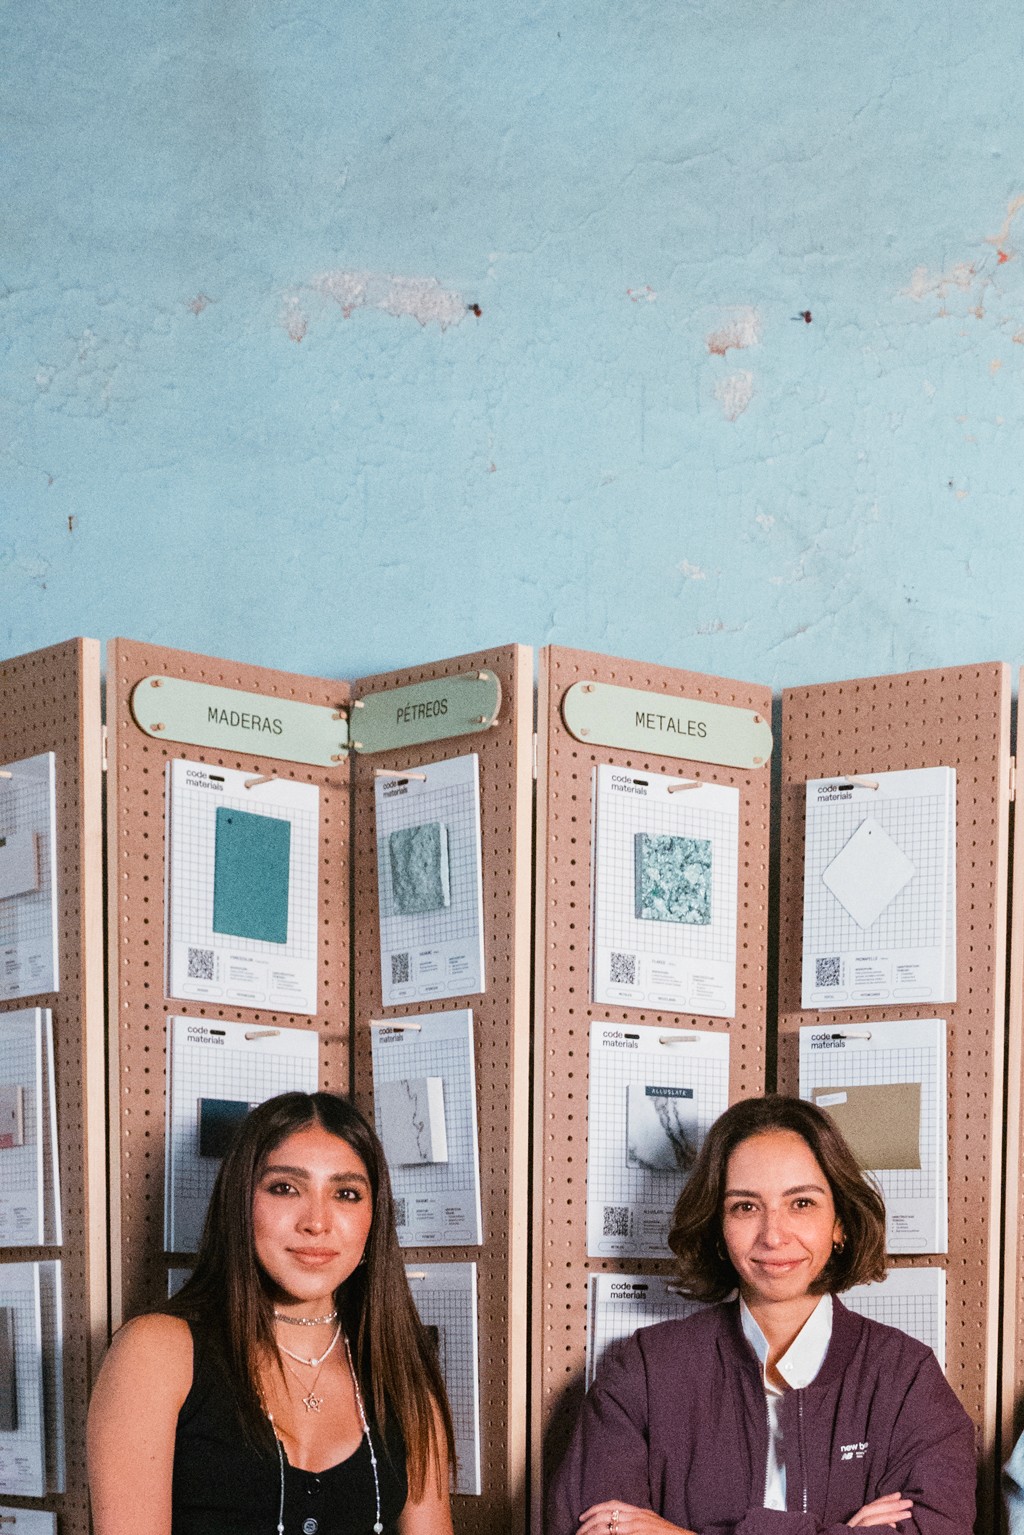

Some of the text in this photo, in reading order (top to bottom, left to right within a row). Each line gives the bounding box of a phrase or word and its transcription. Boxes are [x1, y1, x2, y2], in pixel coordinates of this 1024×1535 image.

[396, 698, 448, 724] PÉTREOS
[208, 706, 283, 735] MADERAS
[636, 711, 707, 738] METALES
[186, 770, 207, 779] code
[611, 775, 631, 783] code
[186, 779, 223, 791] materials
[611, 783, 647, 795] materials
[817, 784, 837, 793] code
[817, 791, 852, 801] materials
[187, 1034, 224, 1045] materials
[602, 1031, 622, 1039] code
[811, 1033, 830, 1041] code
[602, 1039, 638, 1049] materials
[811, 1040, 845, 1049] materials
[651, 1088, 687, 1096] ALLUSLATE
[610, 1282, 631, 1290] code
[610, 1290, 647, 1299] materials
[840, 1444, 858, 1452] new
